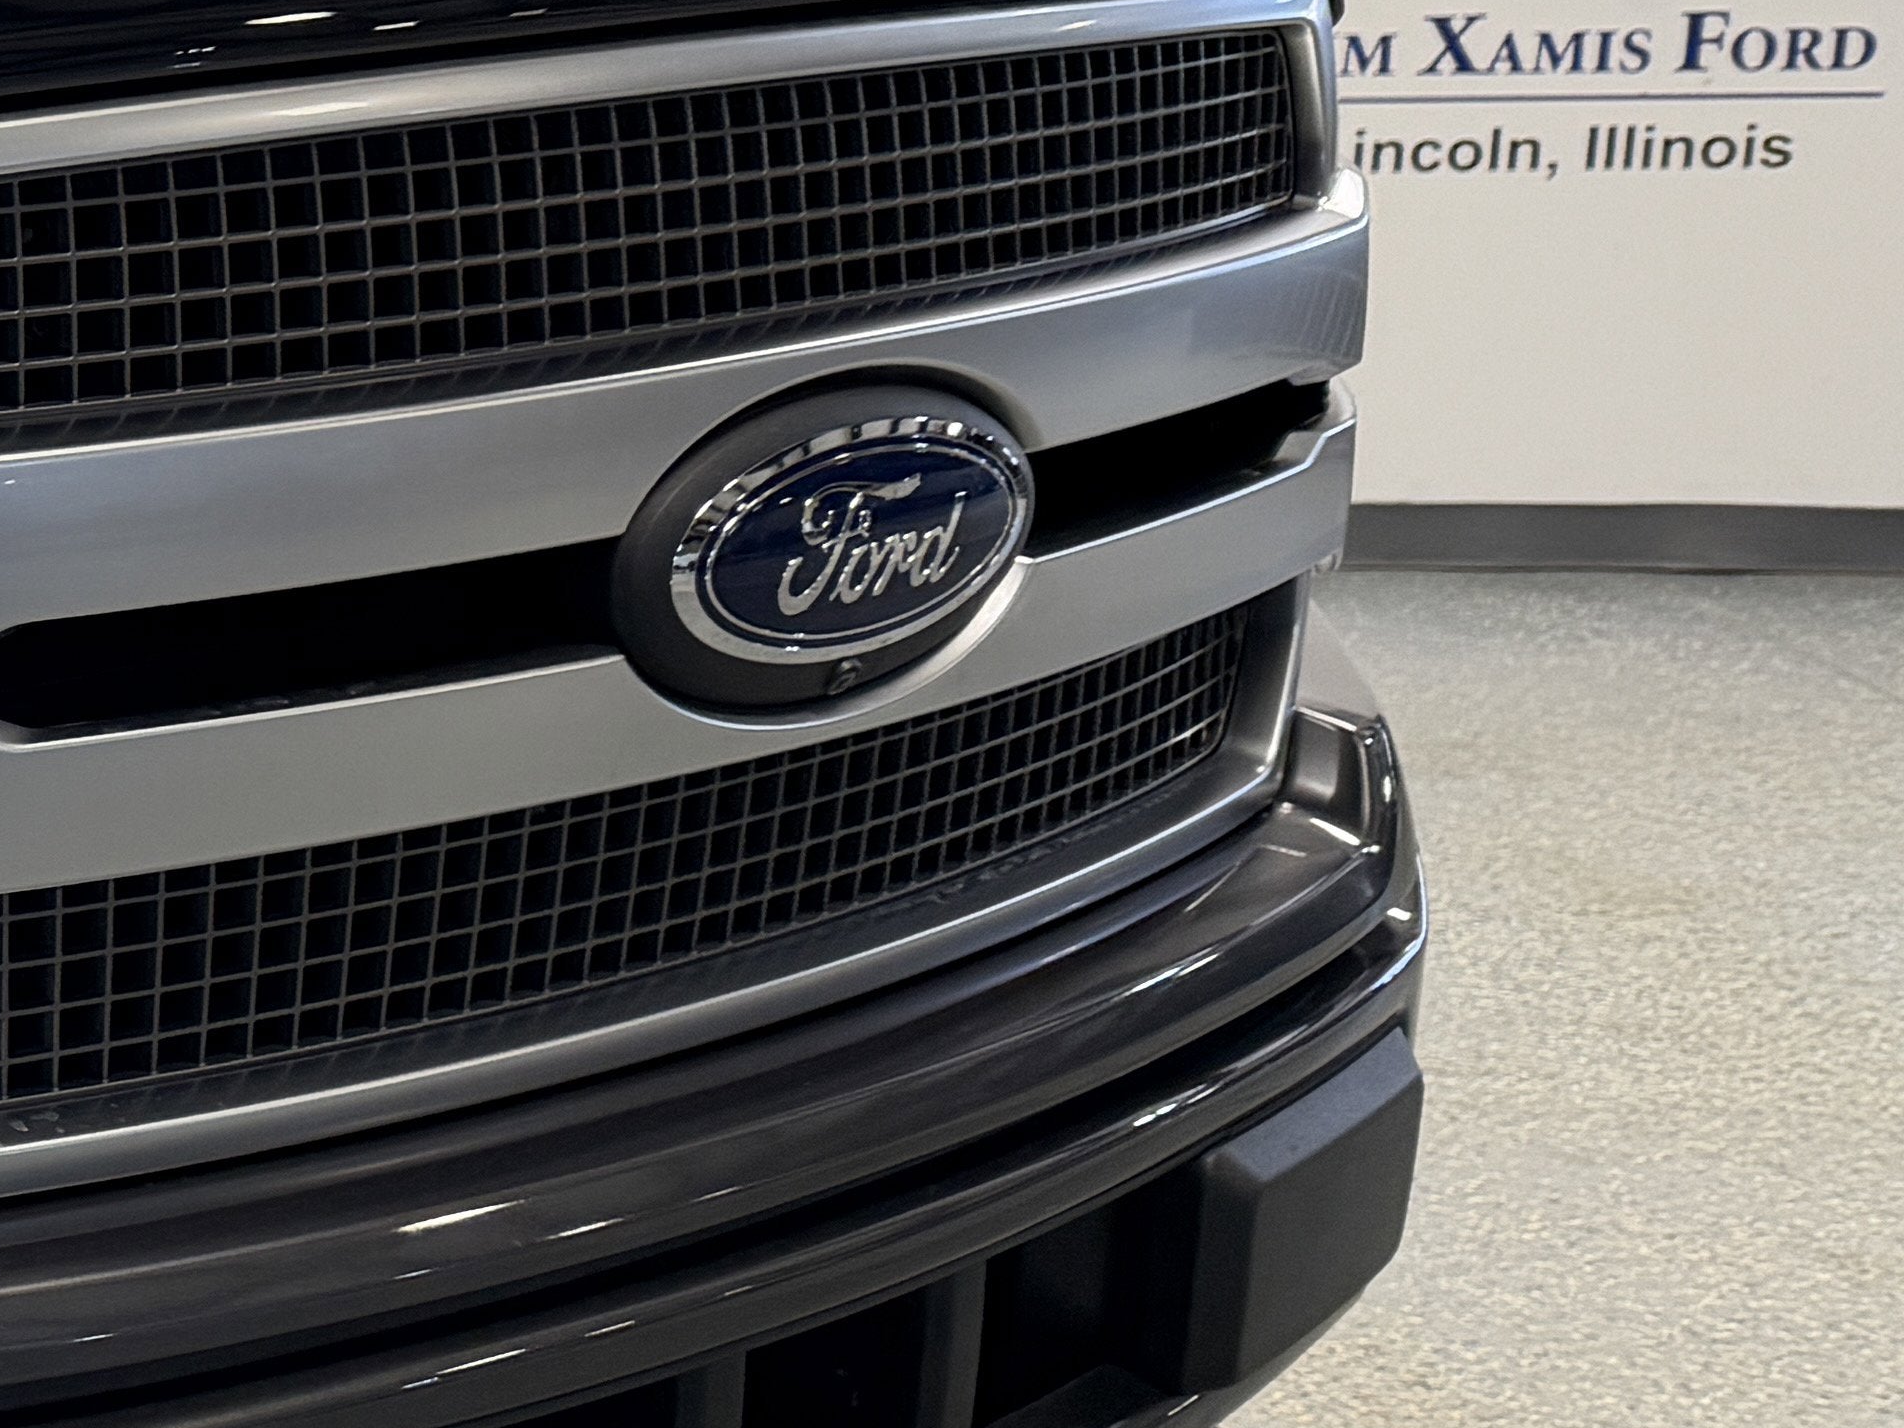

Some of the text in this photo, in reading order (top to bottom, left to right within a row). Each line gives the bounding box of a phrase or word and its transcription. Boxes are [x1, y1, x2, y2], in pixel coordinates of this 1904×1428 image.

[1417, 14, 1651, 76] XAMIS
[1676, 11, 1876, 72] FORD
[1354, 124, 1792, 180] incoln, Illinois
[778, 473, 968, 616] Ford
